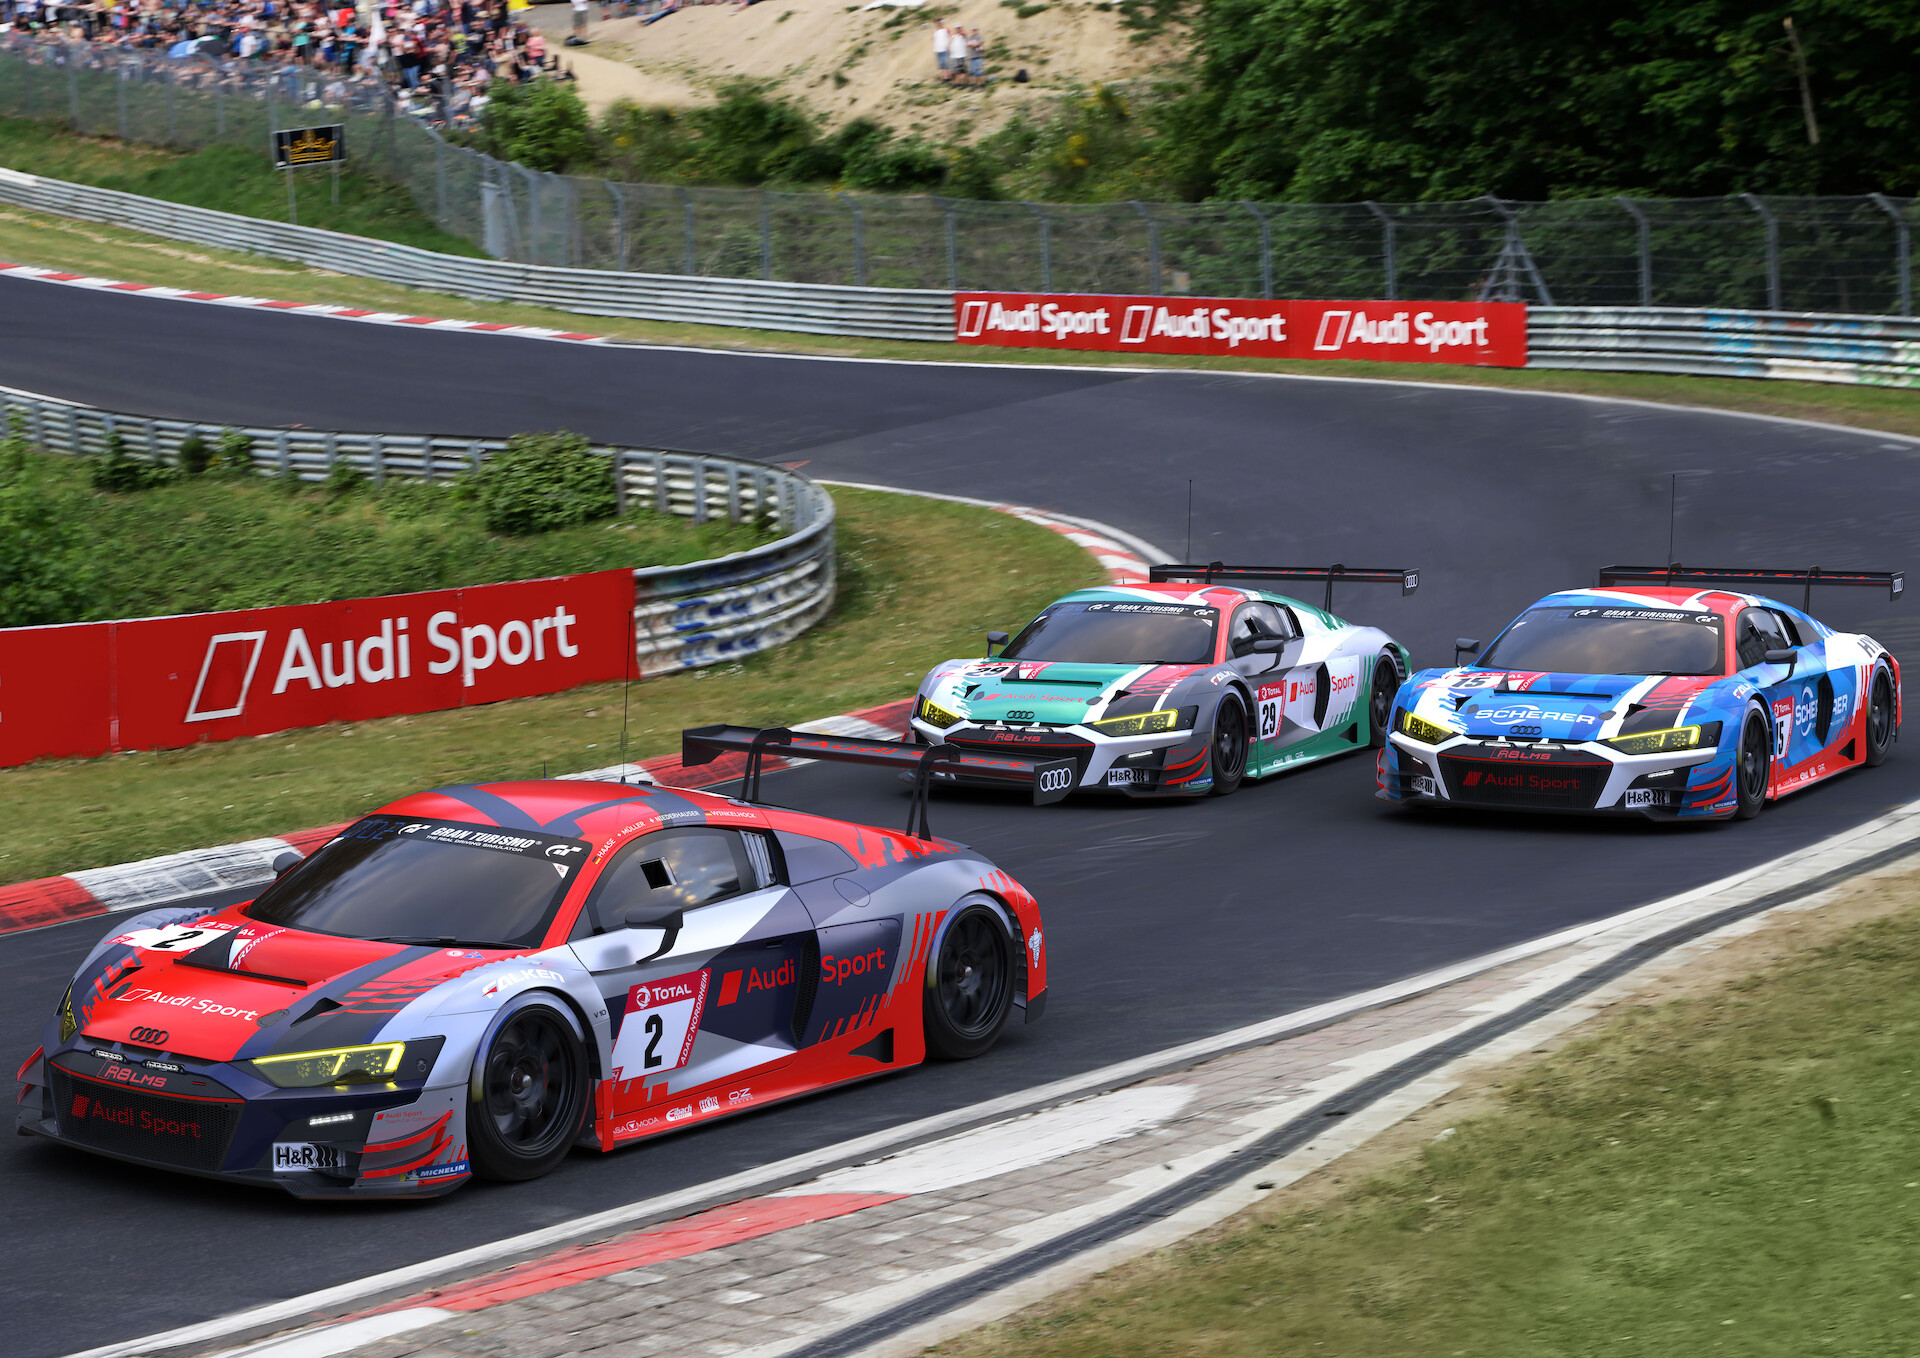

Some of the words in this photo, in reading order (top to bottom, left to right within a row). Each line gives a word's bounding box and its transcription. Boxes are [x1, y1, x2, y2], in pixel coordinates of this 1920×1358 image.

[988, 302, 1040, 333] Audi
[1042, 303, 1110, 340] Sport
[1152, 307, 1211, 339] Audi
[1213, 308, 1287, 347] Sport
[1348, 311, 1410, 345] Audi
[1415, 311, 1489, 353] Sport
[272, 617, 411, 695] Audi
[426, 605, 579, 686] Sport
[965, 666, 1010, 677] 29
[1267, 687, 1282, 696] TOTAL
[1299, 678, 1316, 696] Audi
[1331, 674, 1354, 695] Sport
[1451, 677, 1491, 688] 15
[1039, 694, 1085, 704] Sport
[1262, 702, 1276, 736] 29
[1474, 709, 1596, 724] SCHERER
[800, 740, 899, 755] Audi
[903, 750, 1030, 768] Sort
[1110, 770, 1132, 783] H&R
[1484, 773, 1523, 786] Audi
[1529, 775, 1580, 791] Sport
[1626, 791, 1651, 804] H&R
[655, 810, 701, 822] NIEDERHAUSER
[711, 810, 757, 819] WINKELHOCK
[431, 827, 471, 841] GRAN
[471, 832, 537, 848] TURISMO
[622, 821, 646, 836] MÜLLER
[454, 839, 481, 847] DRIVING
[482, 843, 524, 852] SIMULATOR
[597, 837, 616, 859] HAASE
[151, 931, 204, 949] 2
[747, 959, 796, 994] Audi
[821, 947, 886, 986] Sport
[481, 968, 566, 999] FALKEN
[652, 984, 692, 1001] TOTAL
[143, 991, 196, 1007] Audi
[192, 999, 259, 1021] Sport
[681, 1033, 693, 1065] ADAC
[690, 971, 708, 1033] NORDRHEIN
[644, 1013, 663, 1070] 2
[92, 1100, 134, 1127] Audi
[140, 1110, 201, 1138] Sport
[277, 1147, 315, 1167] H&R
[420, 1164, 466, 1177] MICHELIN
